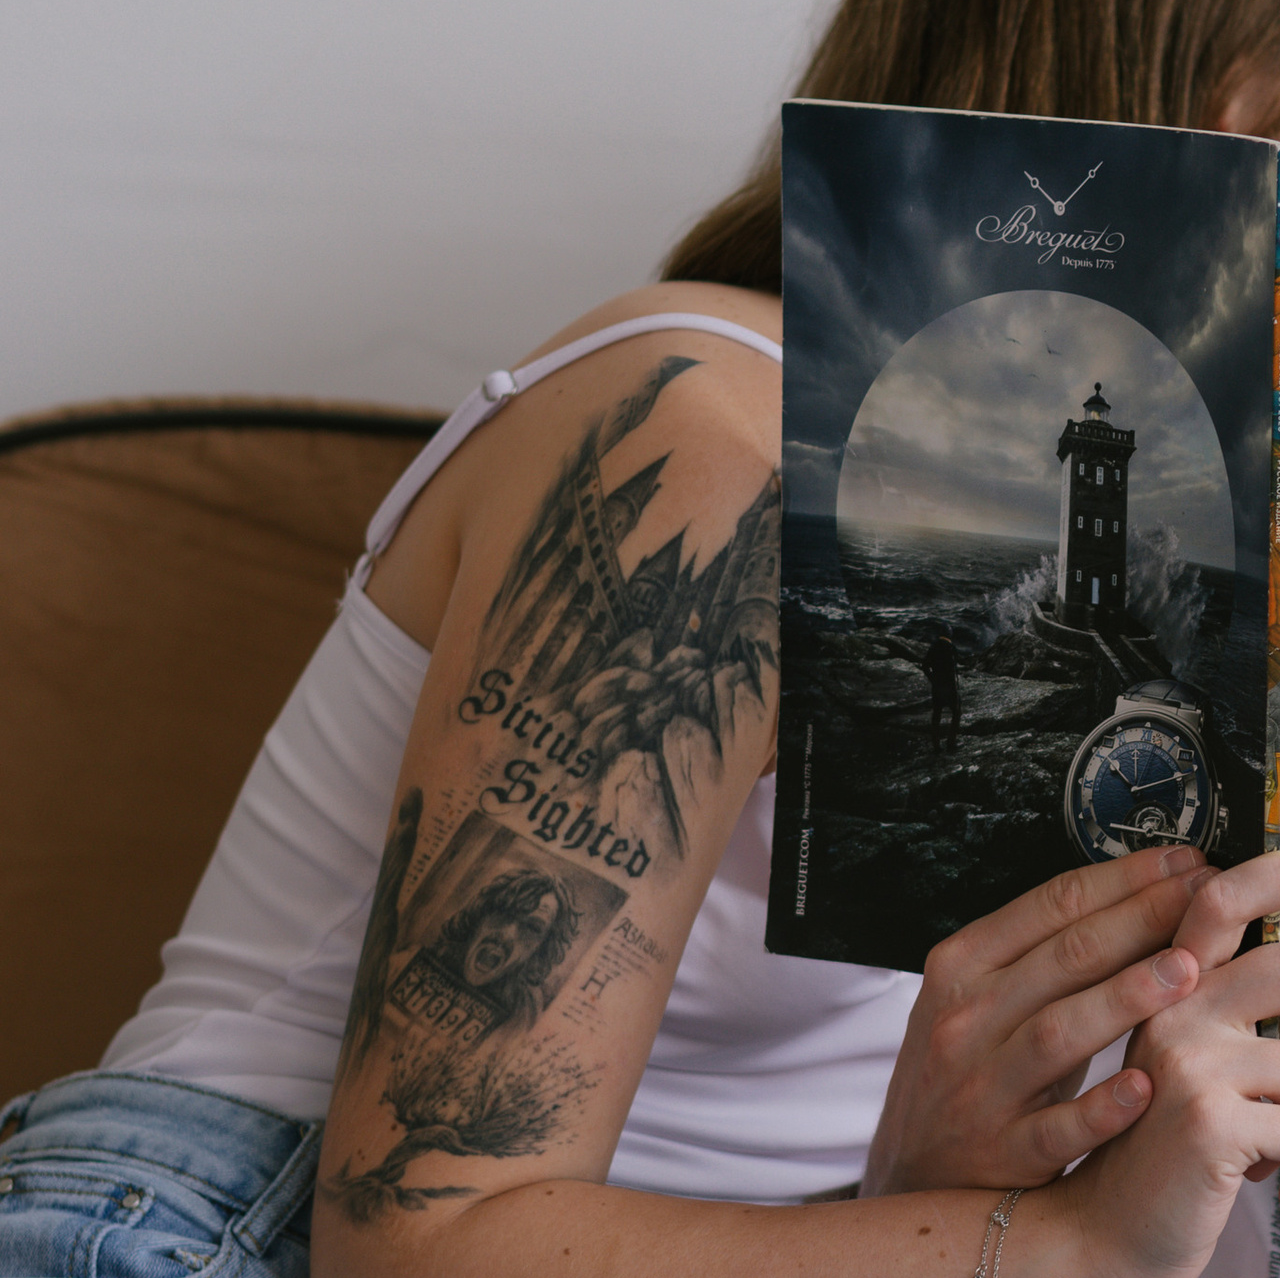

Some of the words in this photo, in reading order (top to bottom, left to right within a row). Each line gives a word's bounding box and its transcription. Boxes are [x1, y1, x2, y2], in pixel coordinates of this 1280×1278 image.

[975, 204, 1125, 265] Breguet
[1061, 255, 1093, 269] Depuis
[458, 669, 597, 778] Sirius
[479, 759, 651, 878] Sighted
[795, 829, 810, 916] BREGUET.COM
